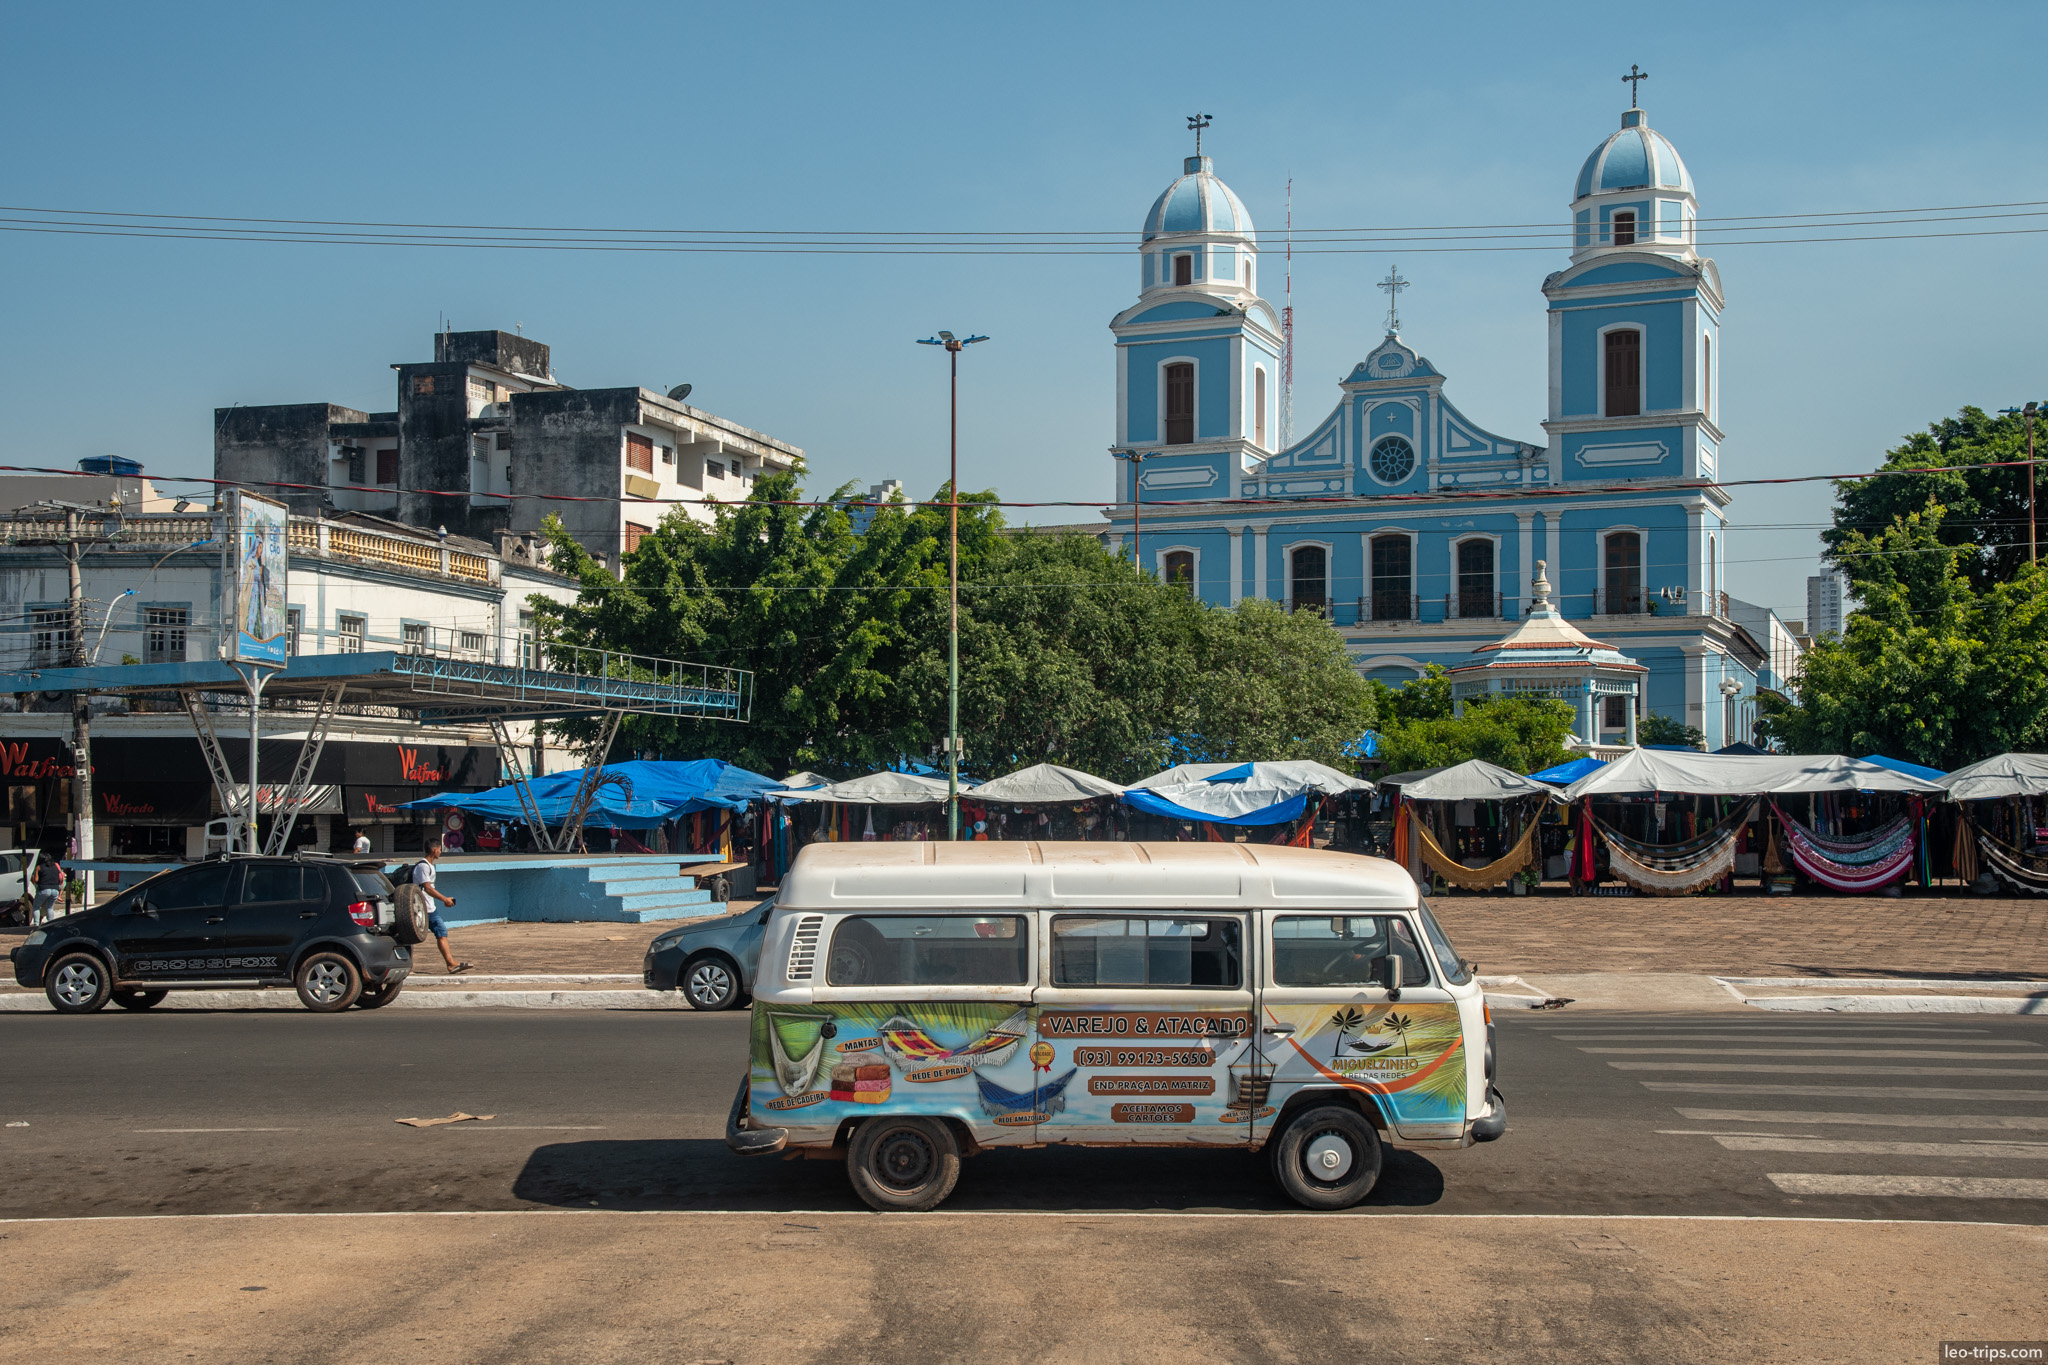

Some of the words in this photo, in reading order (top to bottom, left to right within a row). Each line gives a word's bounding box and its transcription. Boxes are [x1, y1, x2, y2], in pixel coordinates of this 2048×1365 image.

[0, 741, 95, 779] Walfre
[398, 745, 451, 784] Walfredo
[102, 792, 154, 815] Walfredo
[133, 956, 278, 971] CROSSFOX
[1049, 1016, 1128, 1034] VAREJO
[1134, 1016, 1149, 1034] &
[1154, 1016, 1247, 1034] ATACADO
[844, 1038, 878, 1050] MANTAS
[1079, 1049, 1111, 1066] (93)
[1118, 1052, 1208, 1065] 99123-5650
[1332, 1059, 1418, 1070] MIGUELZINHO
[911, 1071, 931, 1081] REDE
[933, 1069, 943, 1078] DE
[945, 1066, 968, 1076] PRAIA
[1153, 1080, 1168, 1090] DA
[1170, 1080, 1210, 1090] MATRIZ
[768, 1100, 785, 1110] REDE
[786, 1098, 796, 1107] DE
[796, 1093, 825, 1104] CADEIRA
[1120, 1104, 1182, 1113] ACEITAMOS
[1128, 1112, 1175, 1122] CARTÕES
